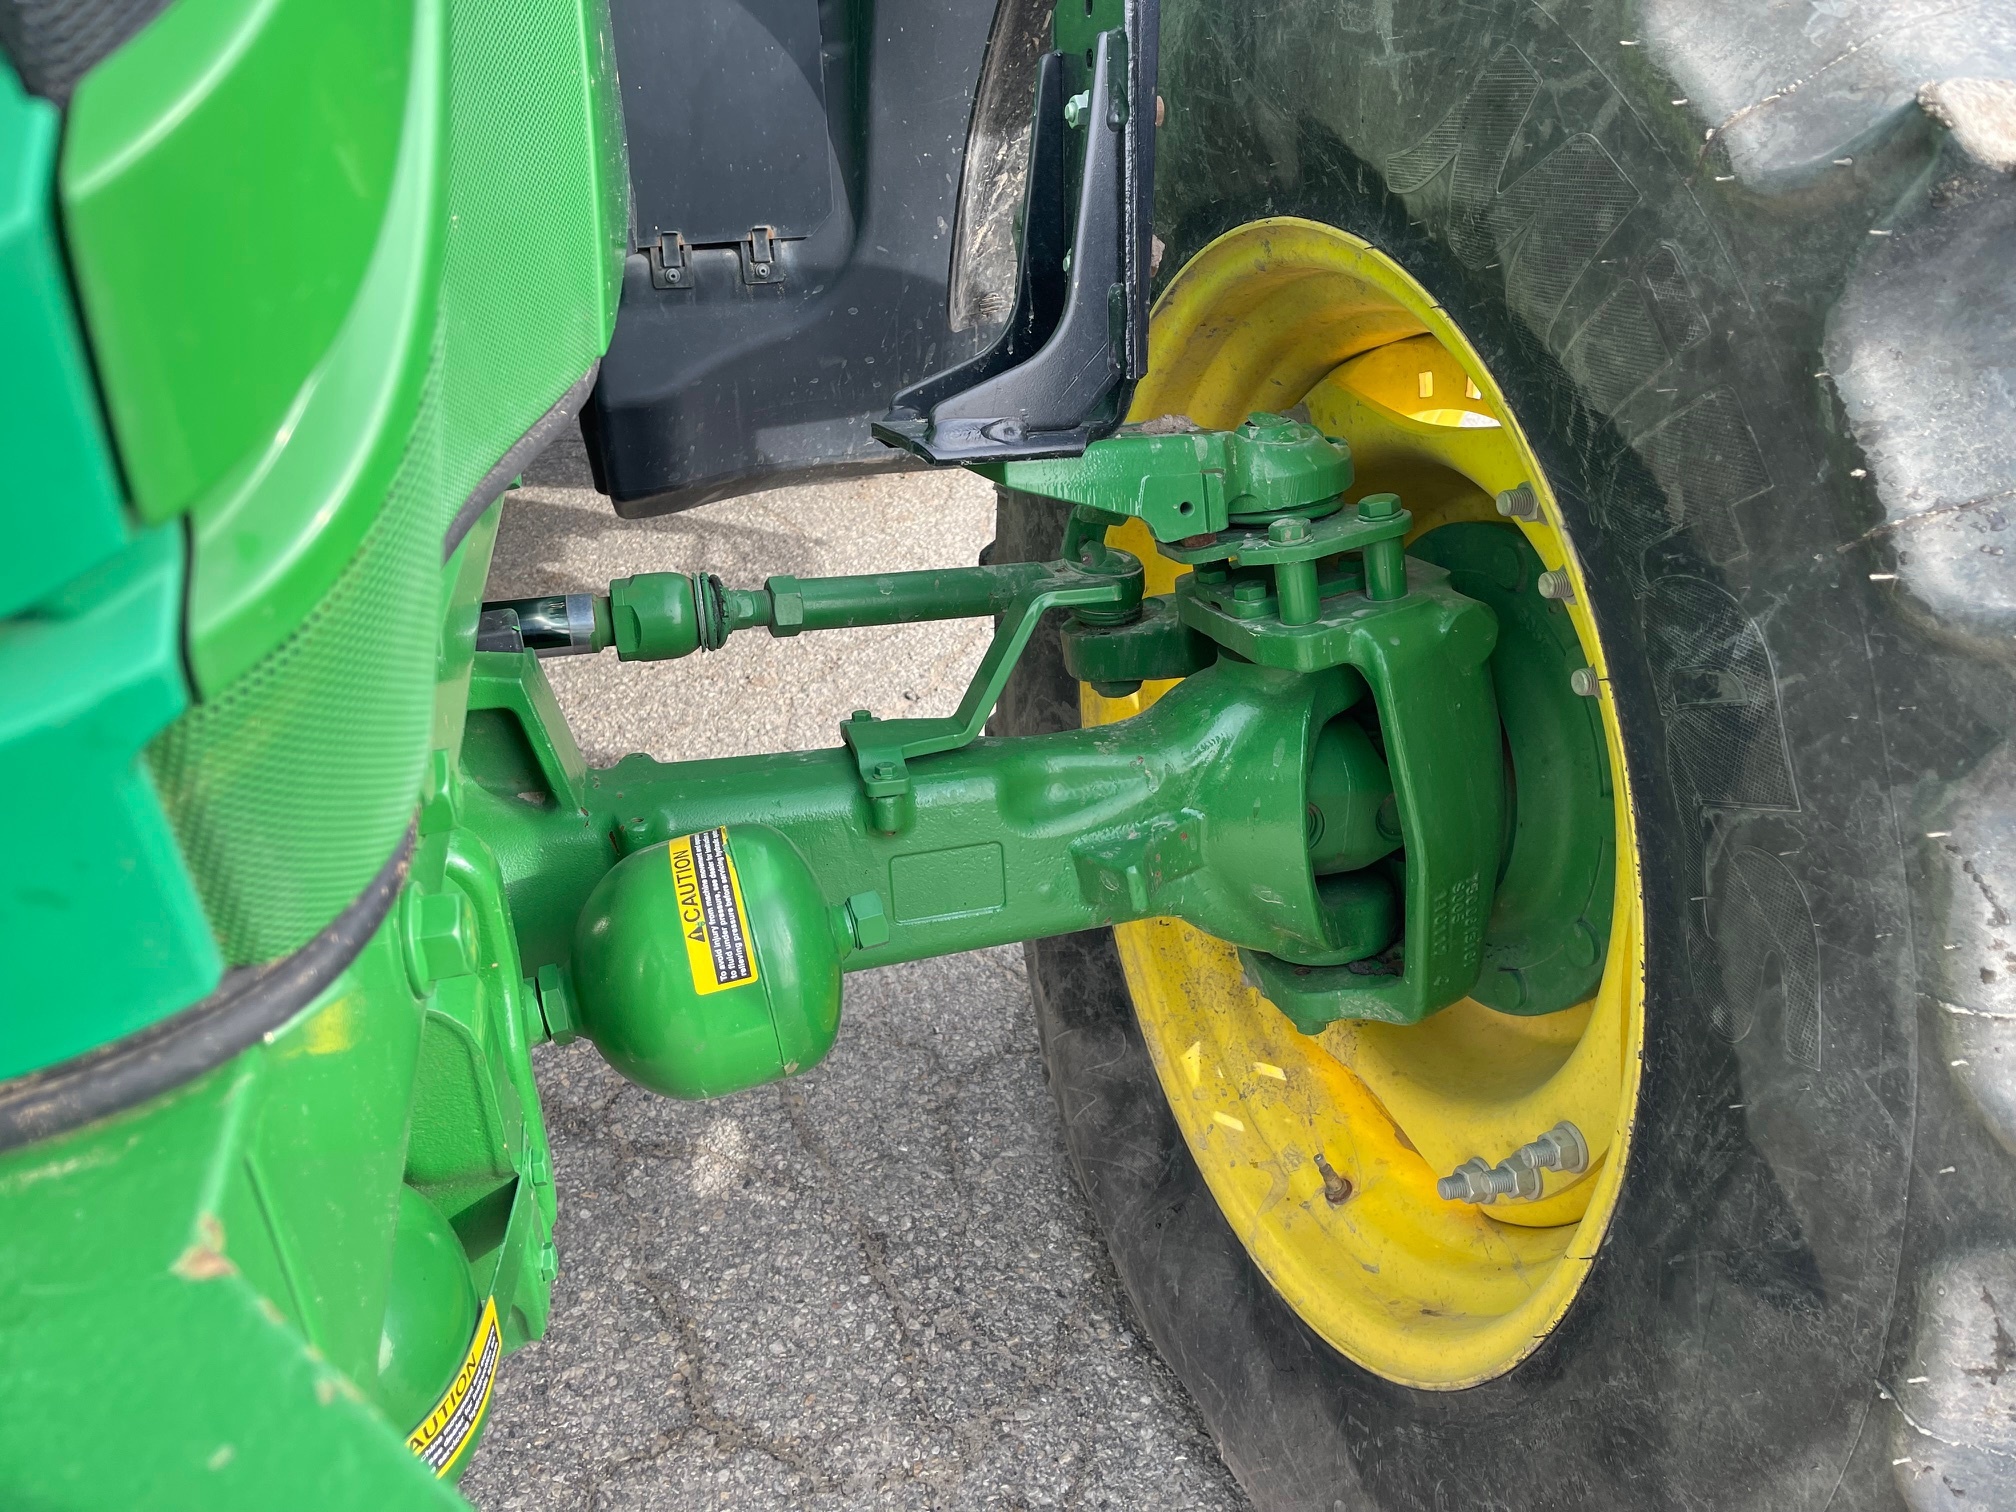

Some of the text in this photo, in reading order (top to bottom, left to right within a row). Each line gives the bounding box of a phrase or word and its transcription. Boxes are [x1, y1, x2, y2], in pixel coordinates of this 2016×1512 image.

[673, 849, 701, 923] CAUTION
[702, 879, 713, 908] machine
[711, 879, 720, 892] see
[722, 884, 734, 908] before
[706, 907, 717, 926] from
[727, 907, 742, 942] pressure
[710, 926, 722, 949] injury
[721, 927, 732, 950] under
[714, 948, 726, 970] avoid
[725, 950, 736, 970] fluid
[734, 942, 748, 977] relieving
[719, 970, 728, 982] To
[730, 969, 738, 979] to
[409, 1352, 477, 1452] AUTION
